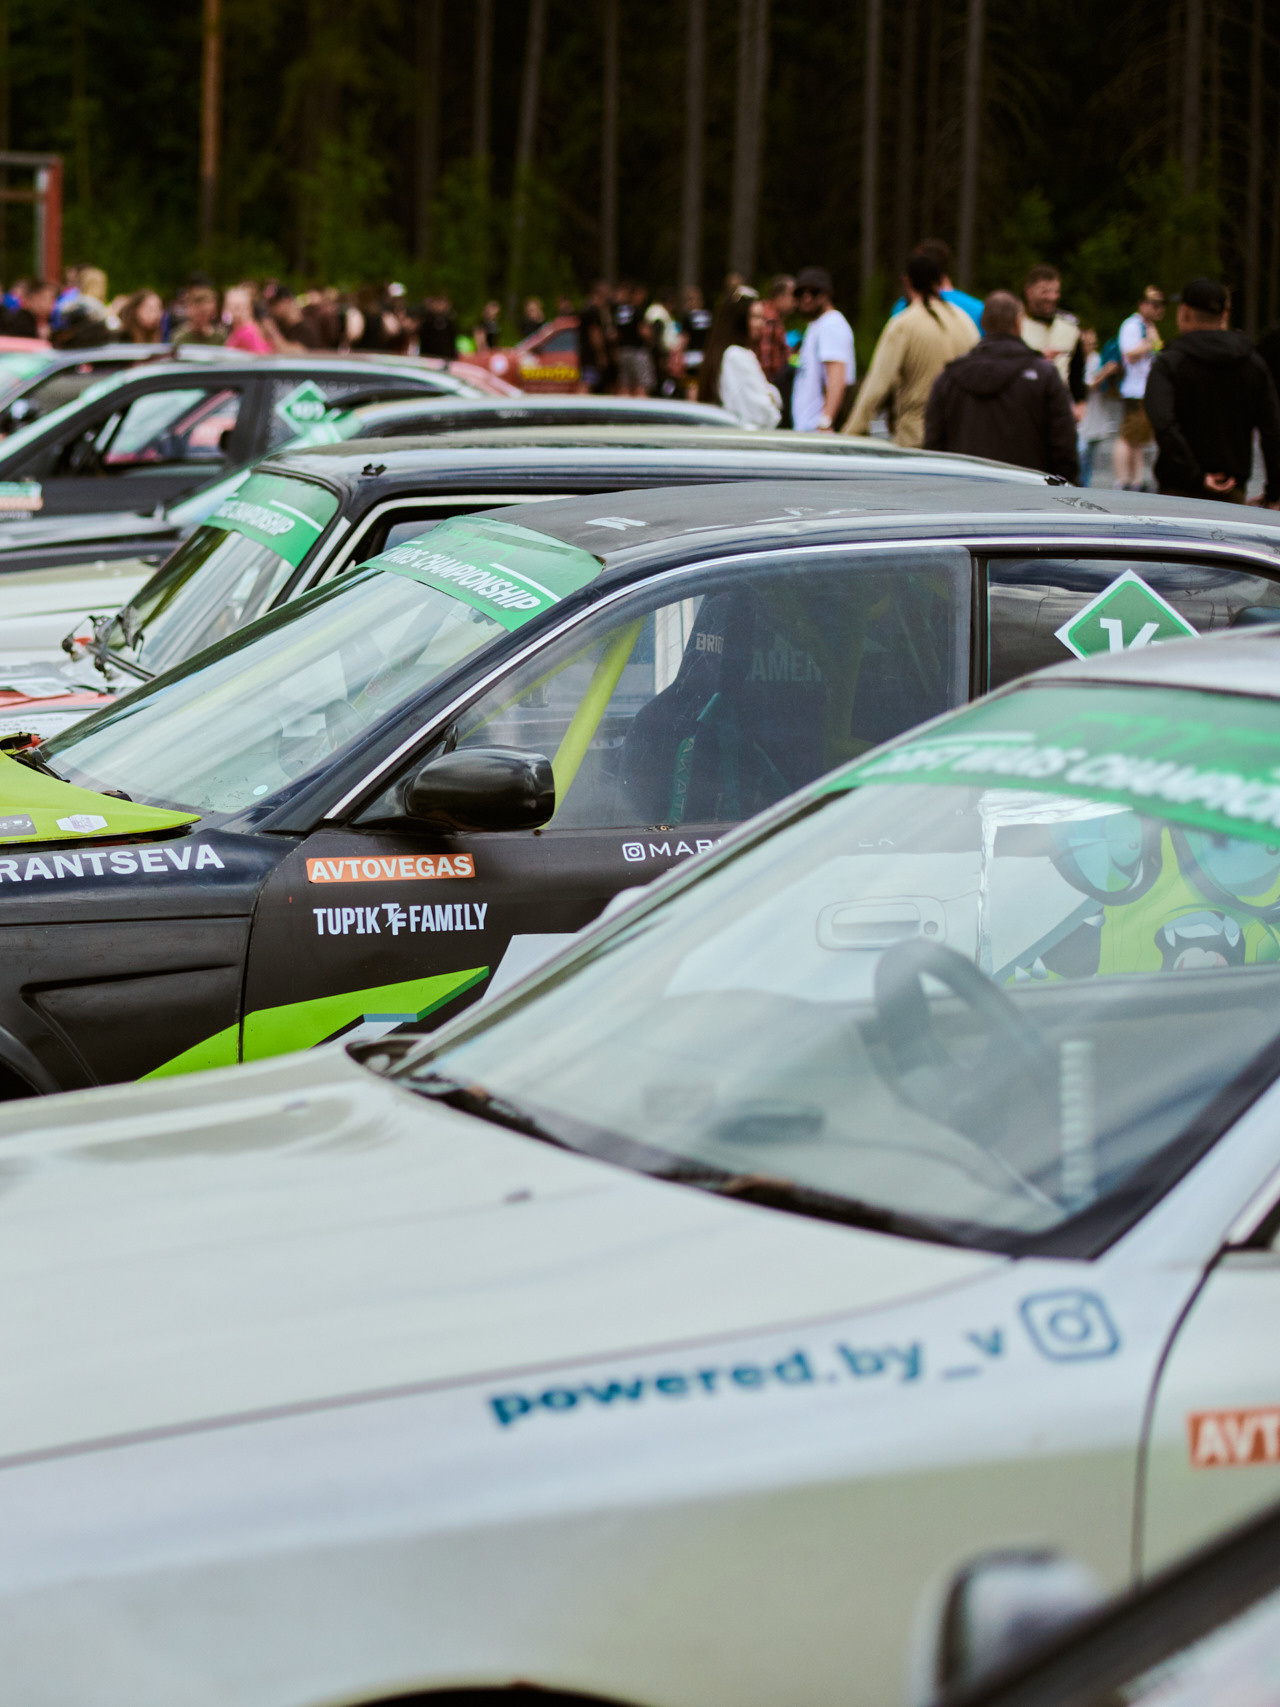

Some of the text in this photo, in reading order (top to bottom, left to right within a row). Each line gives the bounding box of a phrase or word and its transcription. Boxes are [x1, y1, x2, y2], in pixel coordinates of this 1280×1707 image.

[411, 551, 542, 610] CHAMPIONSHIP
[648, 840, 721, 858] MAR
[311, 855, 473, 880] AVTOVEGAS
[313, 906, 381, 935] TUPIK
[409, 902, 488, 933] FAMILY
[488, 1324, 1009, 1428] powered.by_v
